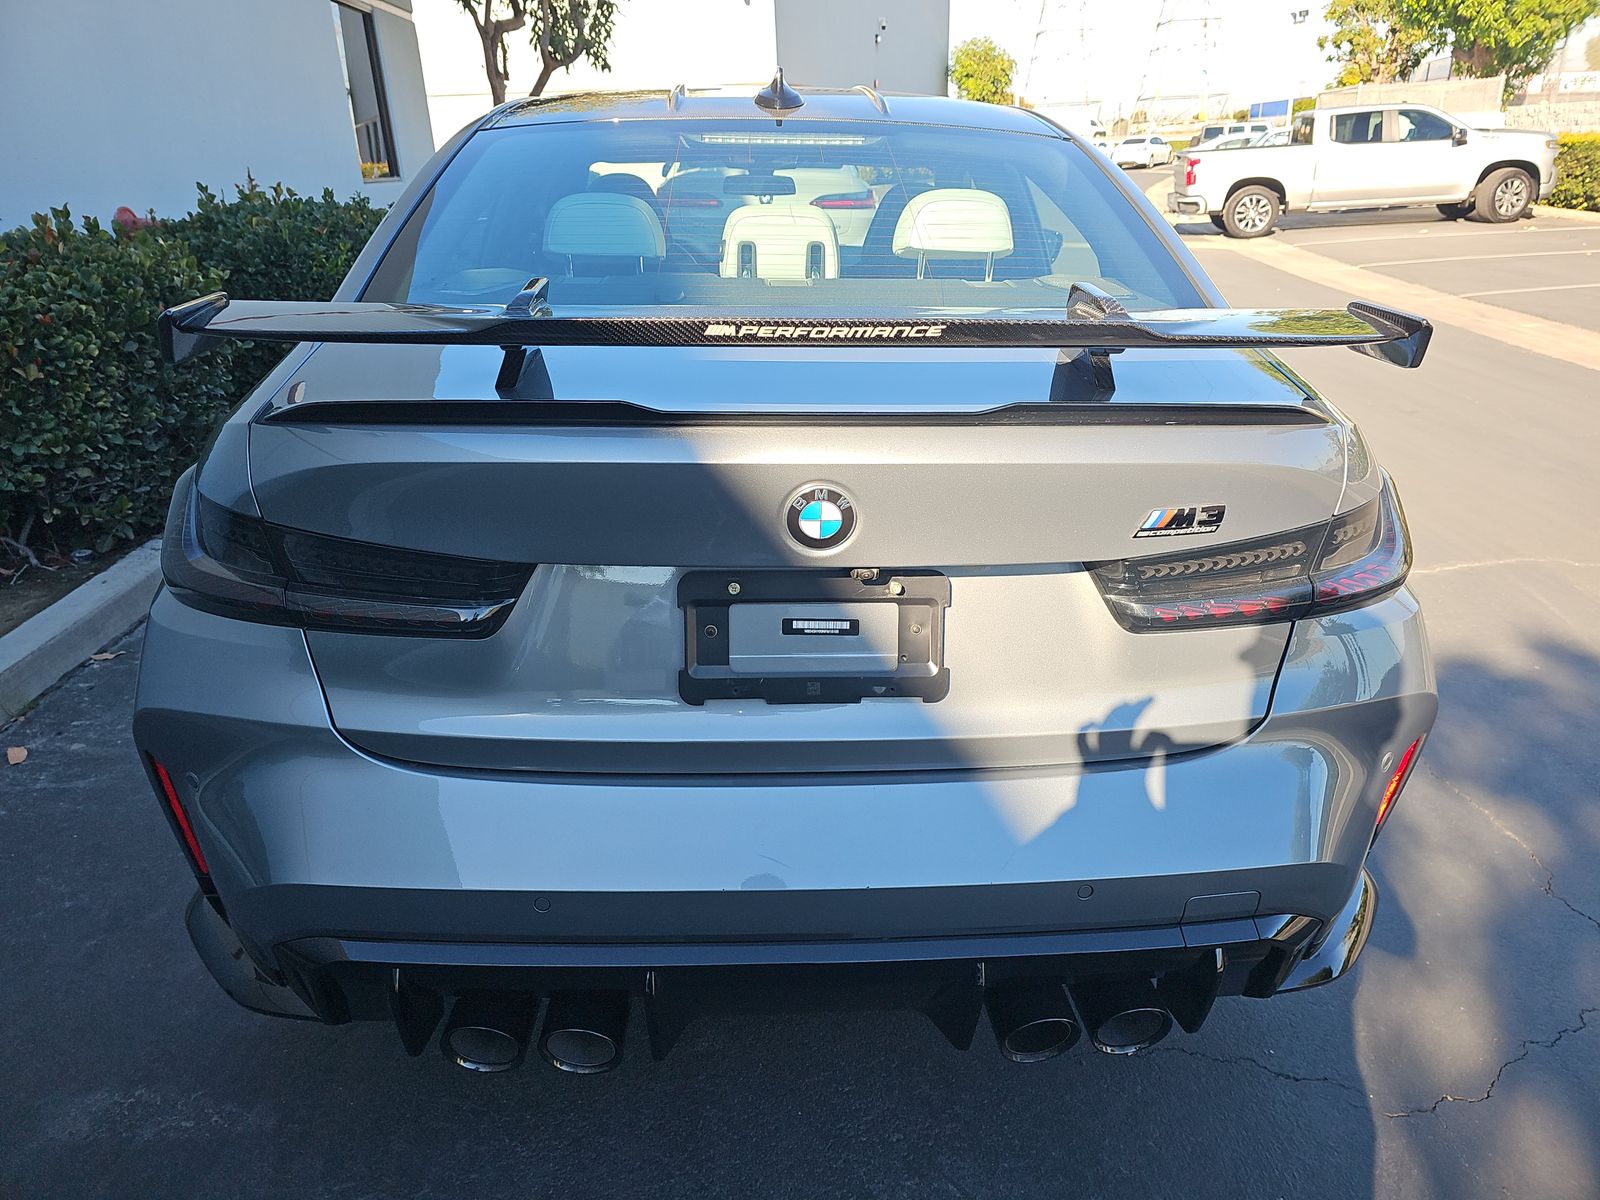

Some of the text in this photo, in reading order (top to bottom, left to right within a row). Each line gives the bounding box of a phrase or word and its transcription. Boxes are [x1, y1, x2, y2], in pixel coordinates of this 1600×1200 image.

[738, 324, 947, 338] PERFORMANCE
[792, 489, 851, 511] BMW
[1163, 505, 1226, 529] M3
